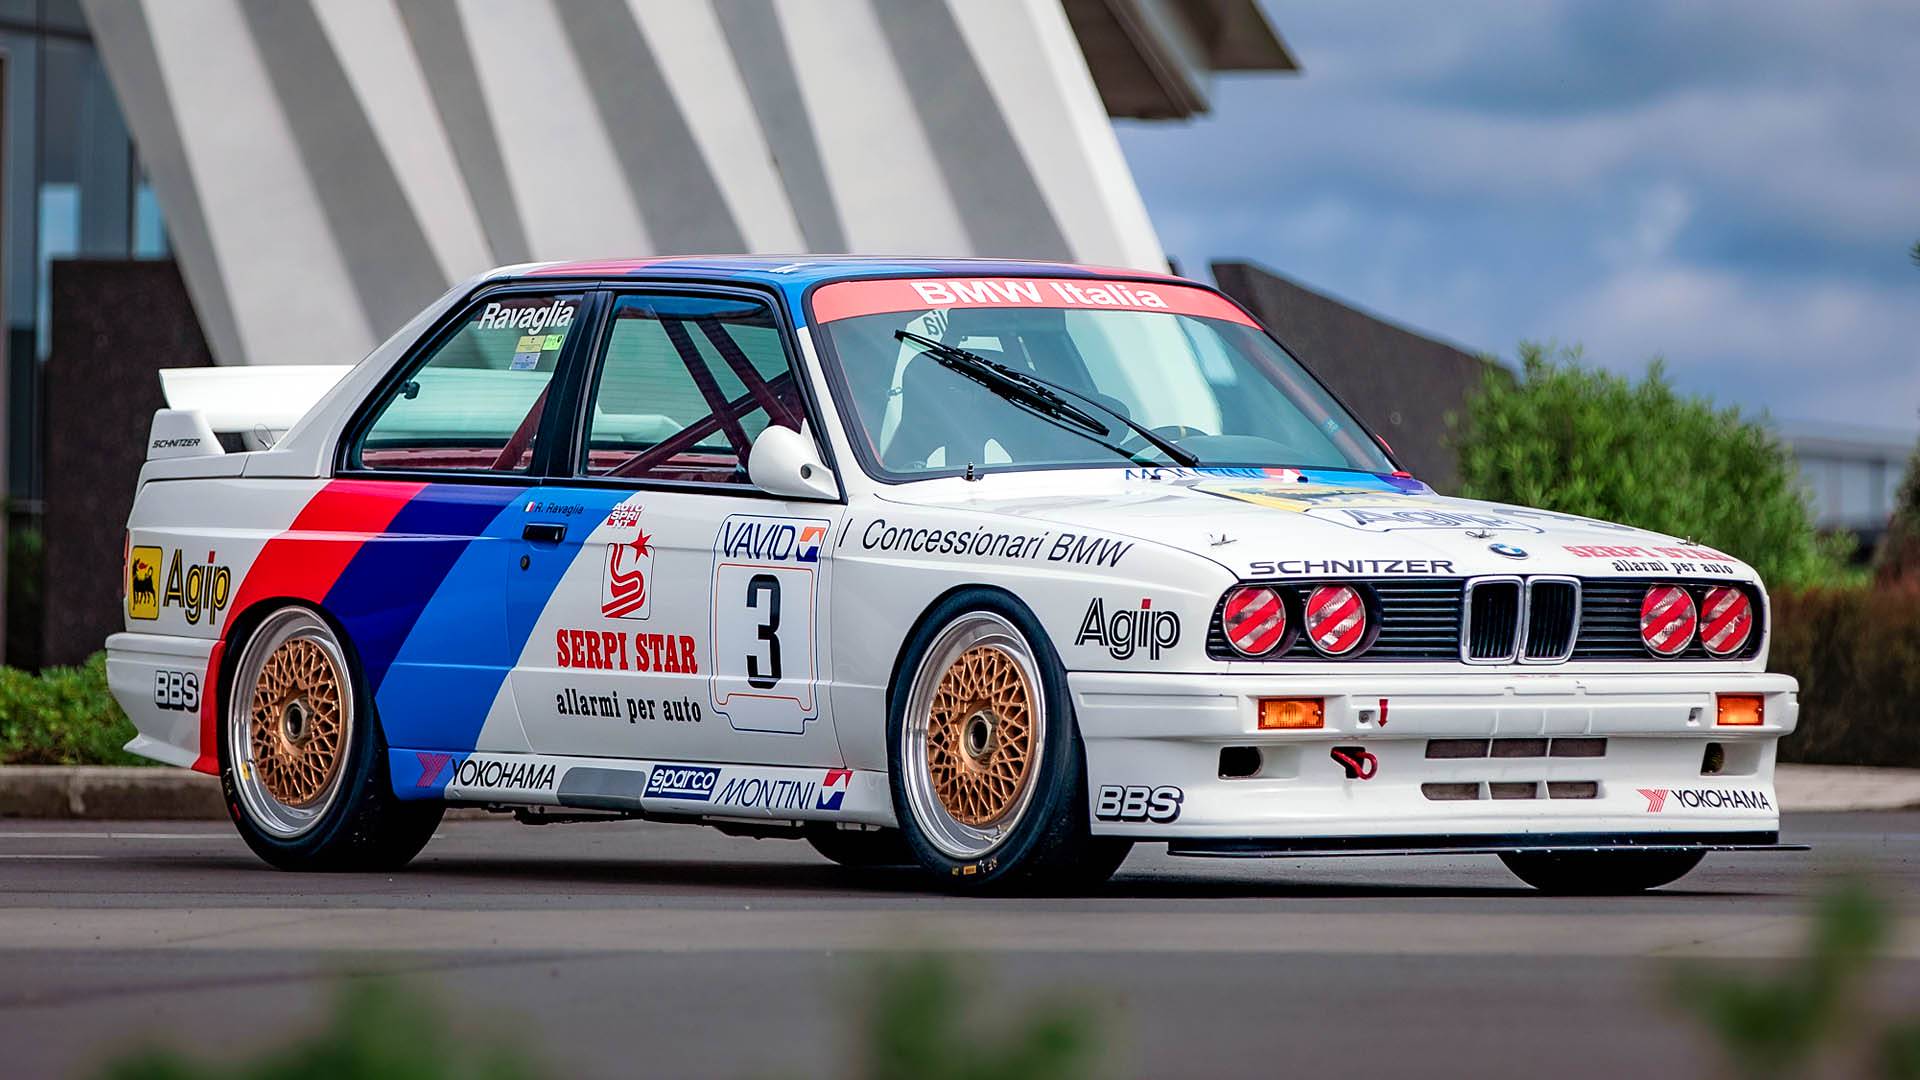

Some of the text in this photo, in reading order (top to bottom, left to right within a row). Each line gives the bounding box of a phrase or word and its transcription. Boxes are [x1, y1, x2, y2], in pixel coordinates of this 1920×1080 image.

[911, 281, 1168, 308] BMW Italia
[478, 300, 574, 335] Ravaglia
[152, 439, 201, 449] SCHNITZER
[535, 502, 584, 517] R. Ravaglia
[610, 511, 641, 521] SPRI
[612, 503, 645, 512] AUTO
[724, 522, 796, 560] VAVID
[862, 518, 1050, 560] Concessionari
[1047, 533, 1135, 568] BMW
[1562, 545, 1659, 558] SERPI
[1250, 559, 1456, 575] SCHNITZER
[1612, 560, 1735, 575] allarmi per auto
[163, 549, 231, 625] Agip
[746, 574, 782, 689] 3
[1074, 597, 1181, 660] Agip
[556, 629, 698, 674] SERPI STAR
[154, 671, 200, 713] BBS
[556, 688, 701, 723] allarmi per auto
[451, 759, 557, 790] YOKOHAMA
[651, 768, 717, 794] sparco
[714, 777, 816, 810] MONTINI
[1095, 785, 1184, 823] BBS
[1671, 789, 1773, 811] YOKOHAMA
